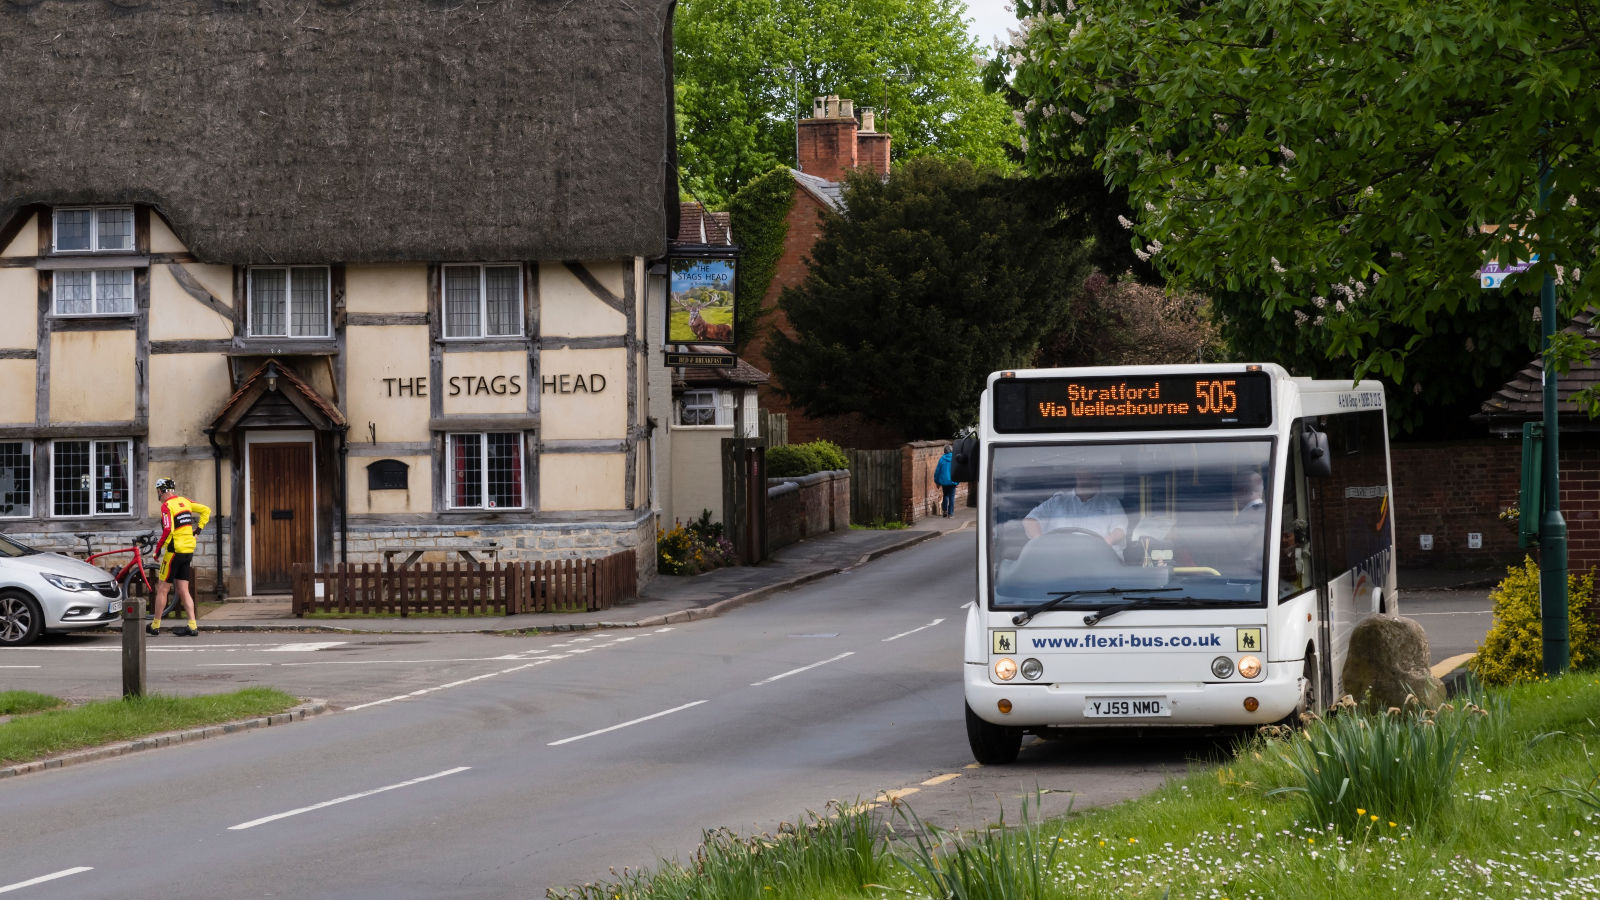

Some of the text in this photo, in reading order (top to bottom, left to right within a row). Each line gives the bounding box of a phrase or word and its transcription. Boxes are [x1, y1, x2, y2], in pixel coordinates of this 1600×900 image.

[678, 273, 728, 281] STAGS HEAD
[697, 265, 710, 273] THE
[382, 373, 607, 397] THE STAGS HEAD
[1067, 382, 1160, 401] Stratford
[1196, 380, 1237, 413] 505
[1039, 400, 1189, 417] Via Wellesbourne
[1032, 633, 1221, 648] www.flexi-bus.co.uk
[1093, 701, 1160, 715] YJ59 NMO
